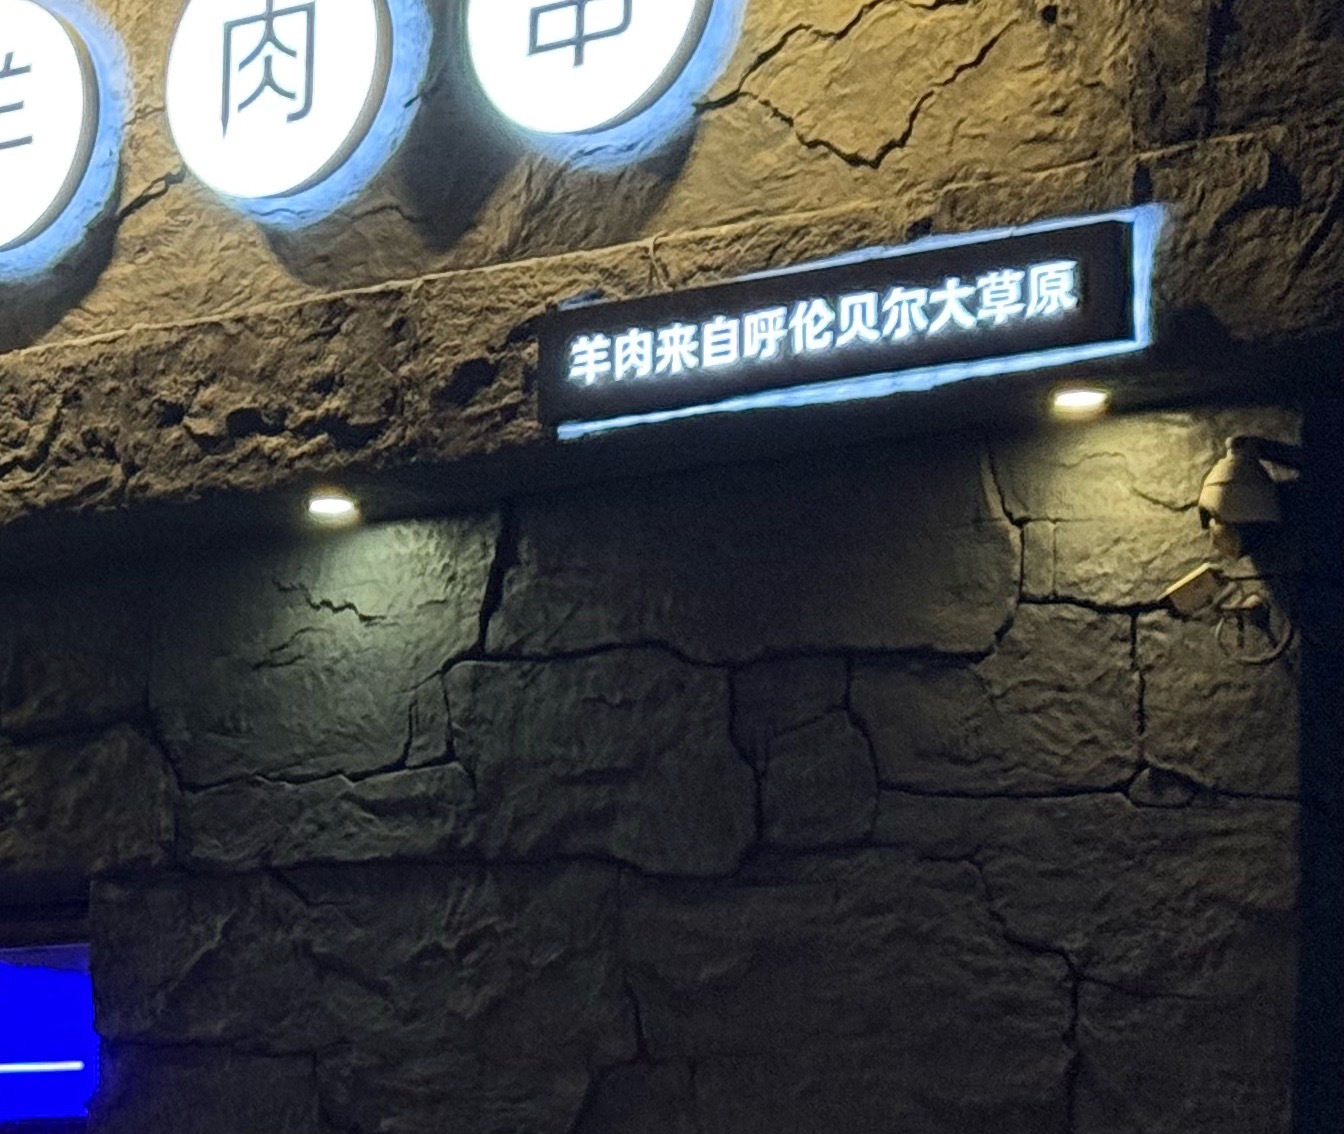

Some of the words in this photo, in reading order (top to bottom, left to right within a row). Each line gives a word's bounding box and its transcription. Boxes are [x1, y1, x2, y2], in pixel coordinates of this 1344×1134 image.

[568, 259, 1080, 386] 羊肉来自呼伦贝尔大草原
